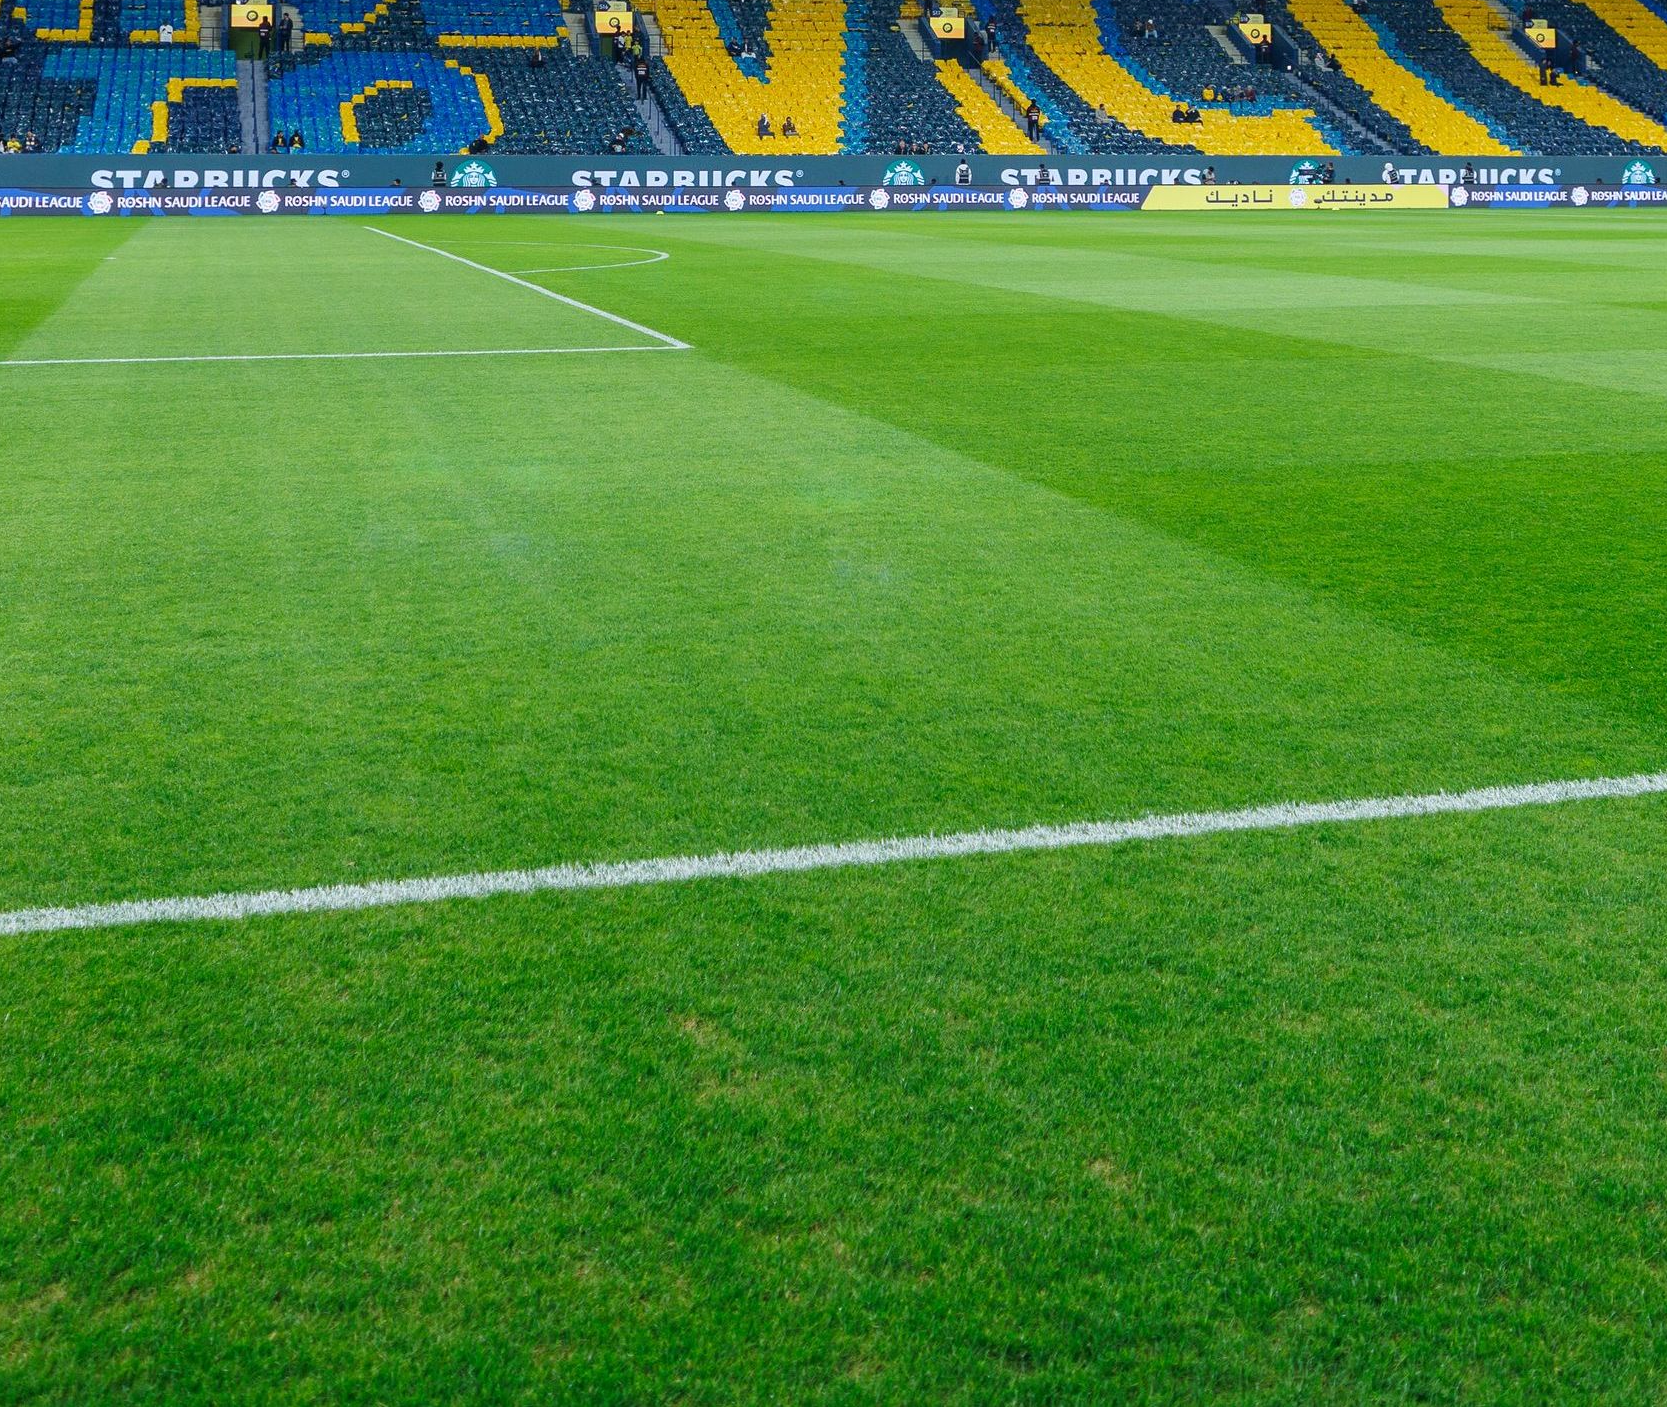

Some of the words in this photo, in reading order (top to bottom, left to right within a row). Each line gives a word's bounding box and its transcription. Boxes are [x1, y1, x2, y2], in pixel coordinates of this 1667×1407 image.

[445, 196, 486, 206] ROSHN
[490, 196, 523, 205] SAUDI
[527, 195, 568, 205] LEAGUE
[600, 195, 639, 205] ROSHN
[642, 195, 675, 205] SAUDI
[678, 195, 718, 205] LEAGUE
[749, 195, 787, 205] ROSHN
[790, 195, 822, 204] SAUDI
[825, 195, 864, 204] LEAGUE
[893, 194, 930, 203] ROSHN
[933, 194, 963, 203] SAUDI
[966, 193, 1004, 203] LEAGUE
[1032, 194, 1067, 203] ROSHN
[1070, 194, 1100, 203] SAUDI
[1103, 193, 1139, 203] LEAGUE
[1471, 192, 1503, 201] ROSHN
[1506, 192, 1533, 201] SAUDI
[1534, 192, 1567, 201] LEAGUE
[1592, 192, 1622, 200] ROSHN
[1624, 191, 1652, 200] SAUDI
[36, 197, 82, 207] LEAGUE
[117, 197, 161, 207] ROSHN
[164, 197, 201, 207] SAUDI
[205, 196, 250, 207] LEAGUE
[285, 196, 327, 206] ROSHN
[330, 196, 366, 206] SAUDI
[369, 196, 412, 206] LEAGUE
